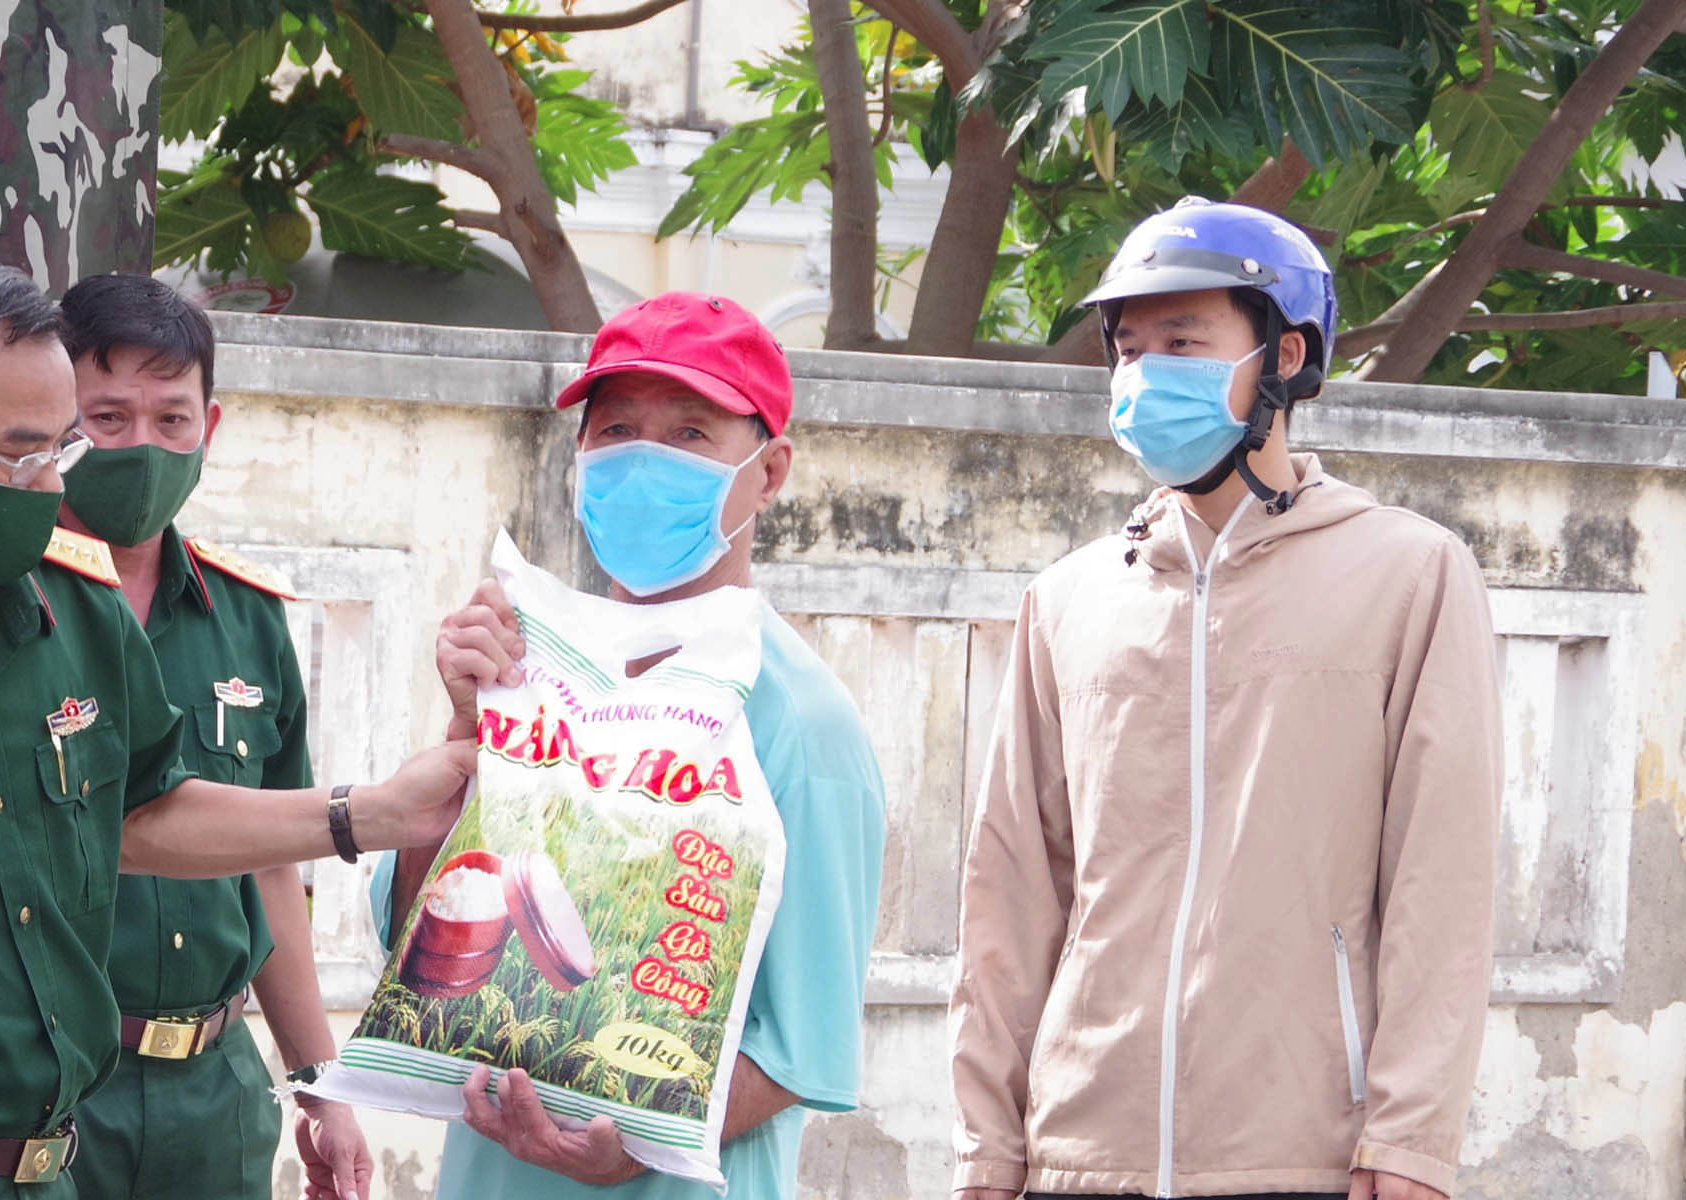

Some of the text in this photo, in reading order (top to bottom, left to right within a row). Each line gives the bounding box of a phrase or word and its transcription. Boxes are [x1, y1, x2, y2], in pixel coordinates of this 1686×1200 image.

[620, 748, 744, 804] HOA
[675, 832, 732, 877] Đặc
[670, 877, 722, 919] Sản
[665, 924, 706, 960] Gò
[635, 960, 709, 1011] Công
[614, 1032, 686, 1073] 10kg
